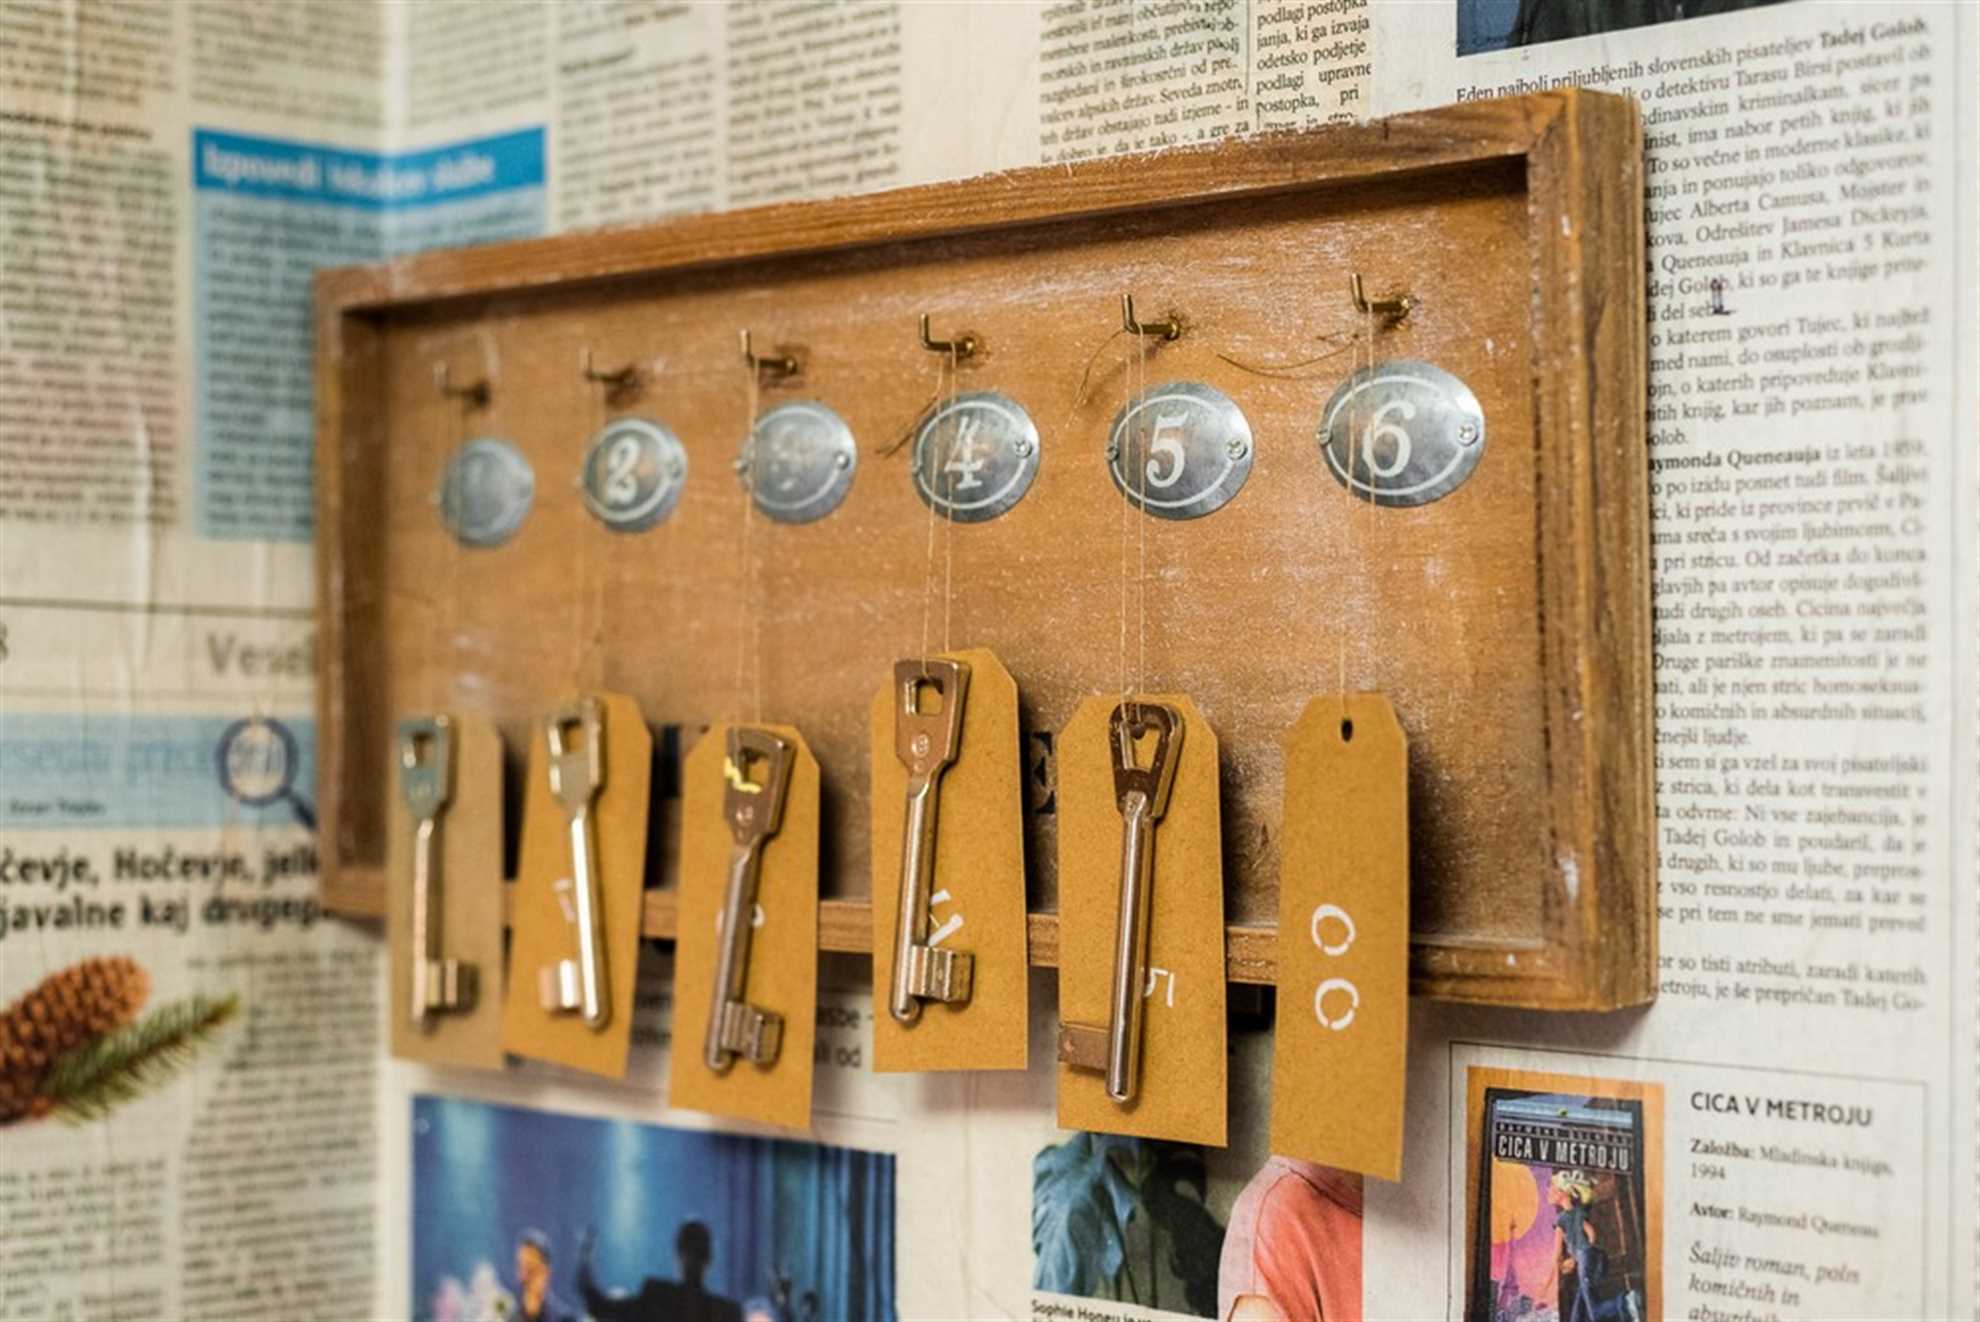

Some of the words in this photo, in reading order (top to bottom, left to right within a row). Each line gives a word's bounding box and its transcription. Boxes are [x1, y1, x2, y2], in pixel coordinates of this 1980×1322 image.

[1257, 4, 1304, 29] podlagi
[1307, 0, 1367, 20] postopka
[1296, 26, 1307, 41] ki
[1311, 27, 1326, 42] ga
[1331, 17, 1369, 35] izvaja
[1257, 49, 1307, 69] odetsko
[1313, 39, 1366, 64] podjetje
[1648, 47, 1731, 74] slovenskih
[1256, 70, 1304, 94] podlagi
[1656, 77, 1729, 98] detektivu
[1736, 70, 1788, 86] Tarasu
[1256, 91, 1319, 115] postopka,
[1340, 86, 1358, 105] pri
[1688, 129, 1717, 143] ima
[1725, 120, 1772, 138] nabor
[1672, 160, 1689, 171] so
[1682, 181, 1697, 195] in
[1704, 171, 1774, 196] ponujajo
[1690, 197, 1748, 217] Alberta
[1661, 249, 1748, 274] Queneauja
[1661, 304, 1683, 320] del
[1666, 327, 1731, 344] katerem
[1696, 374, 1753, 393] katerih
[1146, 412, 1189, 488] 5
[1362, 401, 1416, 478] 6
[944, 416, 983, 490] 4
[1727, 446, 1820, 469] Queneauja
[1664, 829, 1705, 850] Tadej
[1679, 905, 1700, 923] pri
[1707, 905, 1737, 921] tem
[1691, 1092, 1740, 1114] CICA
[1745, 1096, 1760, 1115] V
[1766, 1098, 1872, 1127] METROJU
[1499, 1135, 1533, 1159] CICA
[1540, 1139, 1550, 1161] V
[1556, 1141, 1629, 1171] METROJU
[1691, 1162, 1727, 1181] 1994
[1690, 1201, 1734, 1221] Avtor:
[1689, 1241, 1740, 1270] Šaljiv
[1688, 1273, 1776, 1305] komičnih
